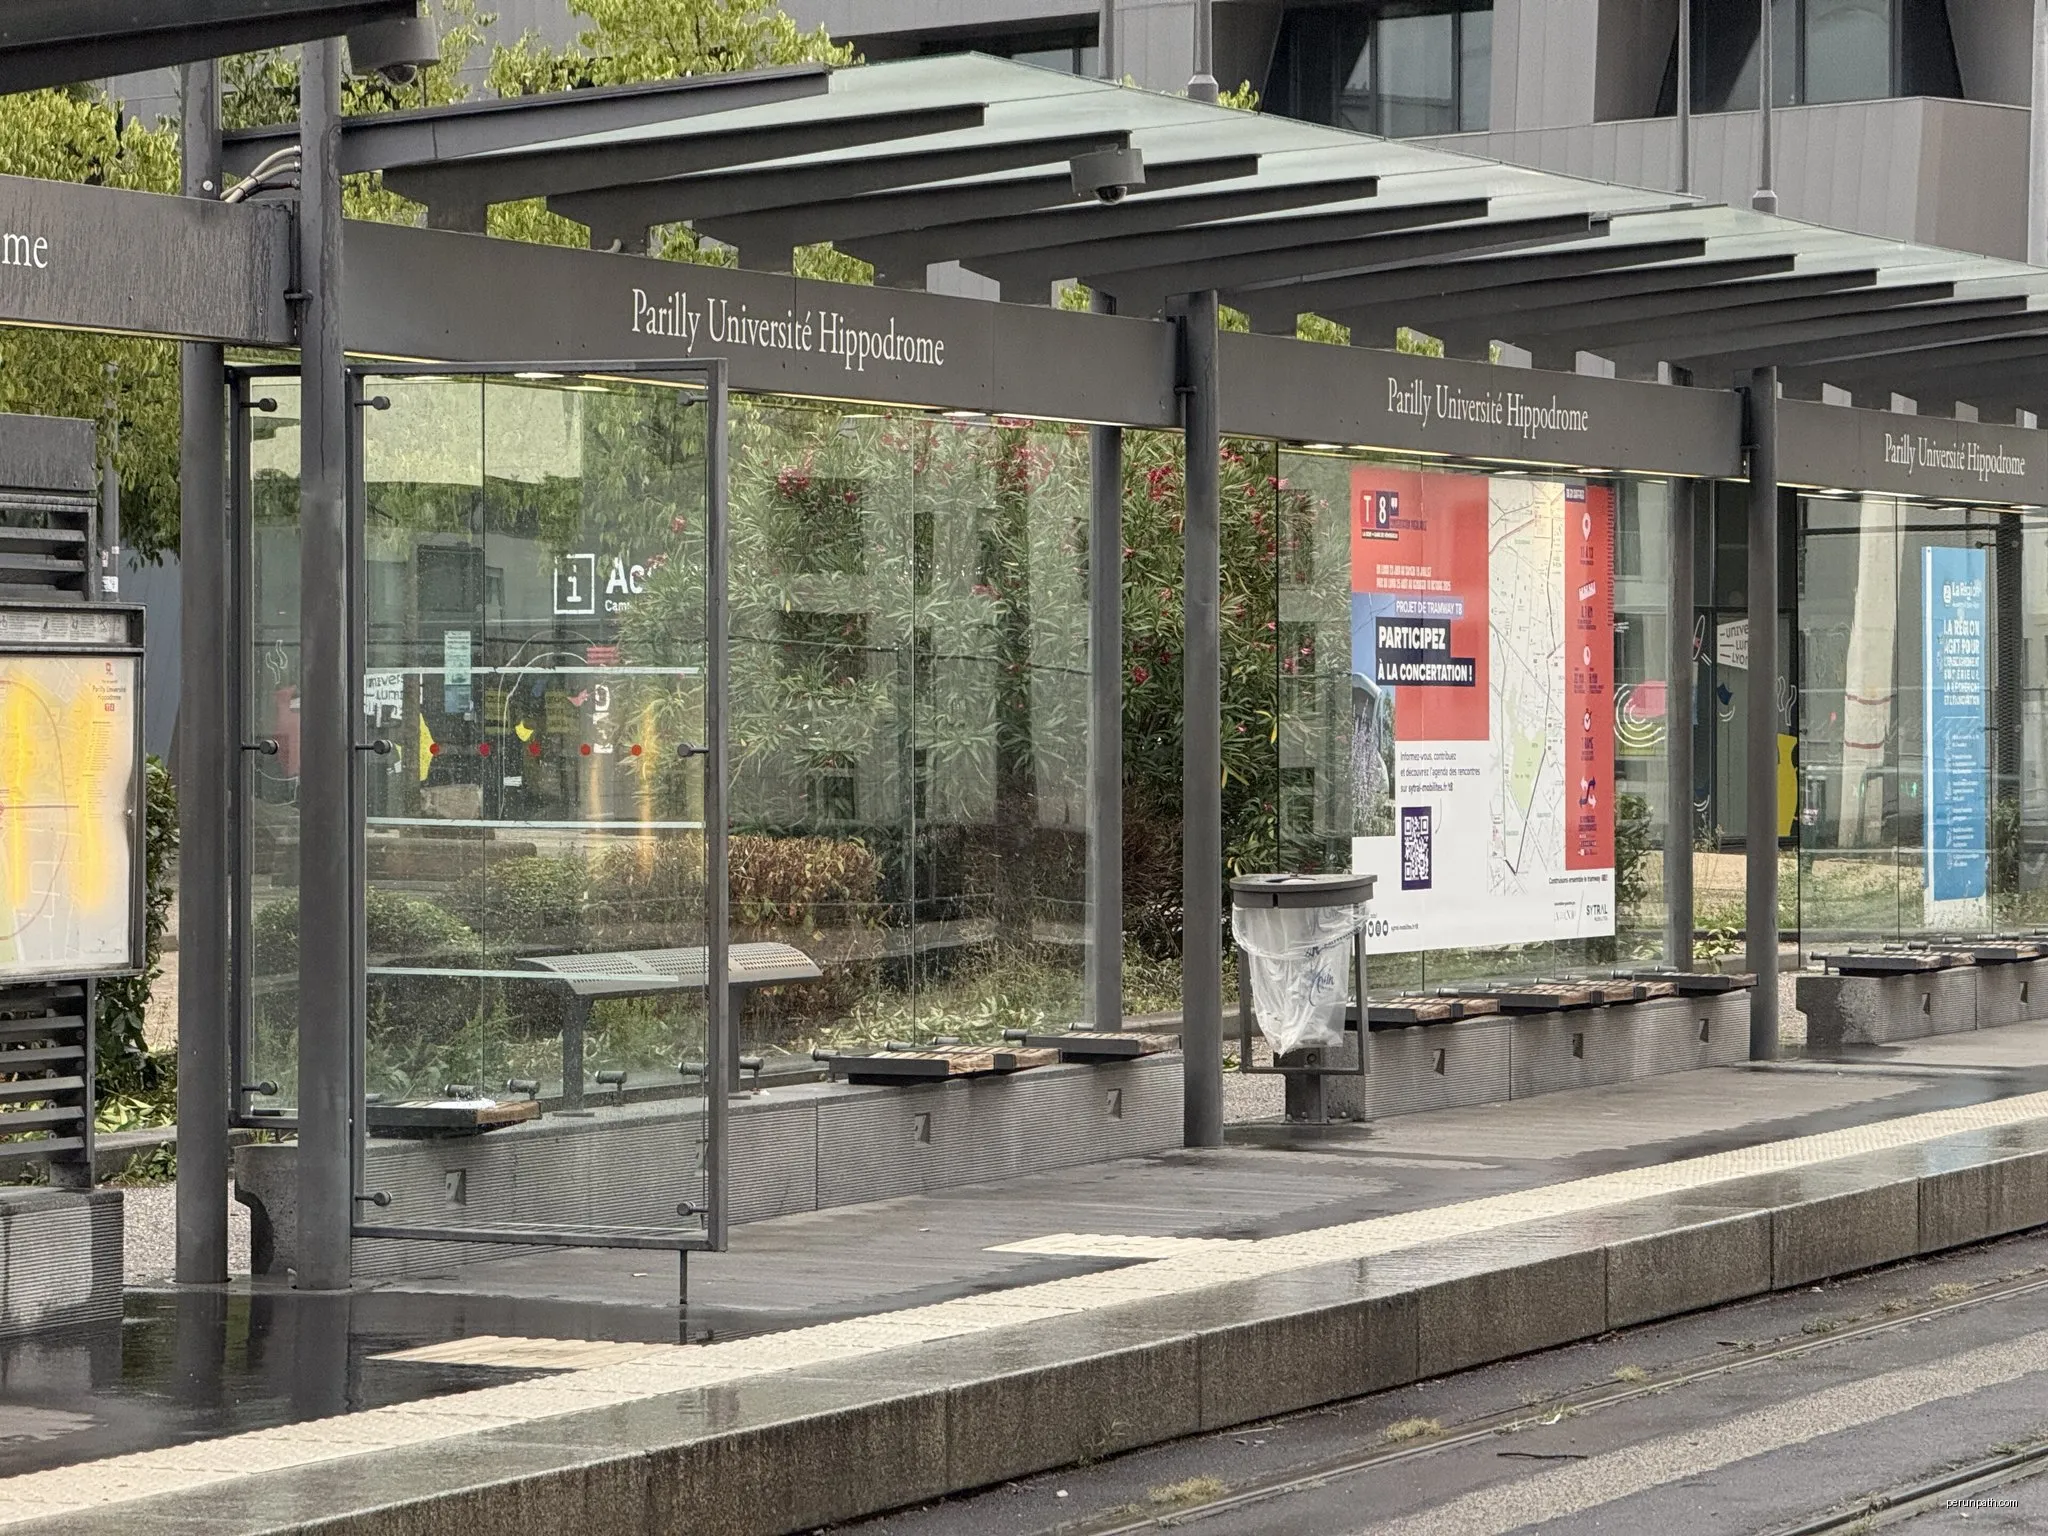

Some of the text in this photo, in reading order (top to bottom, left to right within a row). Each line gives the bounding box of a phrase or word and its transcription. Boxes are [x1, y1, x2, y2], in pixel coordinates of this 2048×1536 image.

[631, 288, 945, 373] Parilly Université Hippodrome
[1387, 377, 1589, 440] Parilly Université Hippodrome
[1884, 433, 2027, 482] Parilly Université Hippodrome
[604, 600, 630, 612] Cam
[1396, 600, 1417, 614] PROJET
[1418, 601, 1427, 614] DE
[1427, 602, 1455, 615] TRAMWAY
[1378, 626, 1446, 650] PARTICIPEZ
[1377, 658, 1385, 680] À
[1386, 663, 1399, 681] LA
[1400, 663, 1468, 682] CONCERTATION
[1586, 904, 1608, 916] SYTRAL
